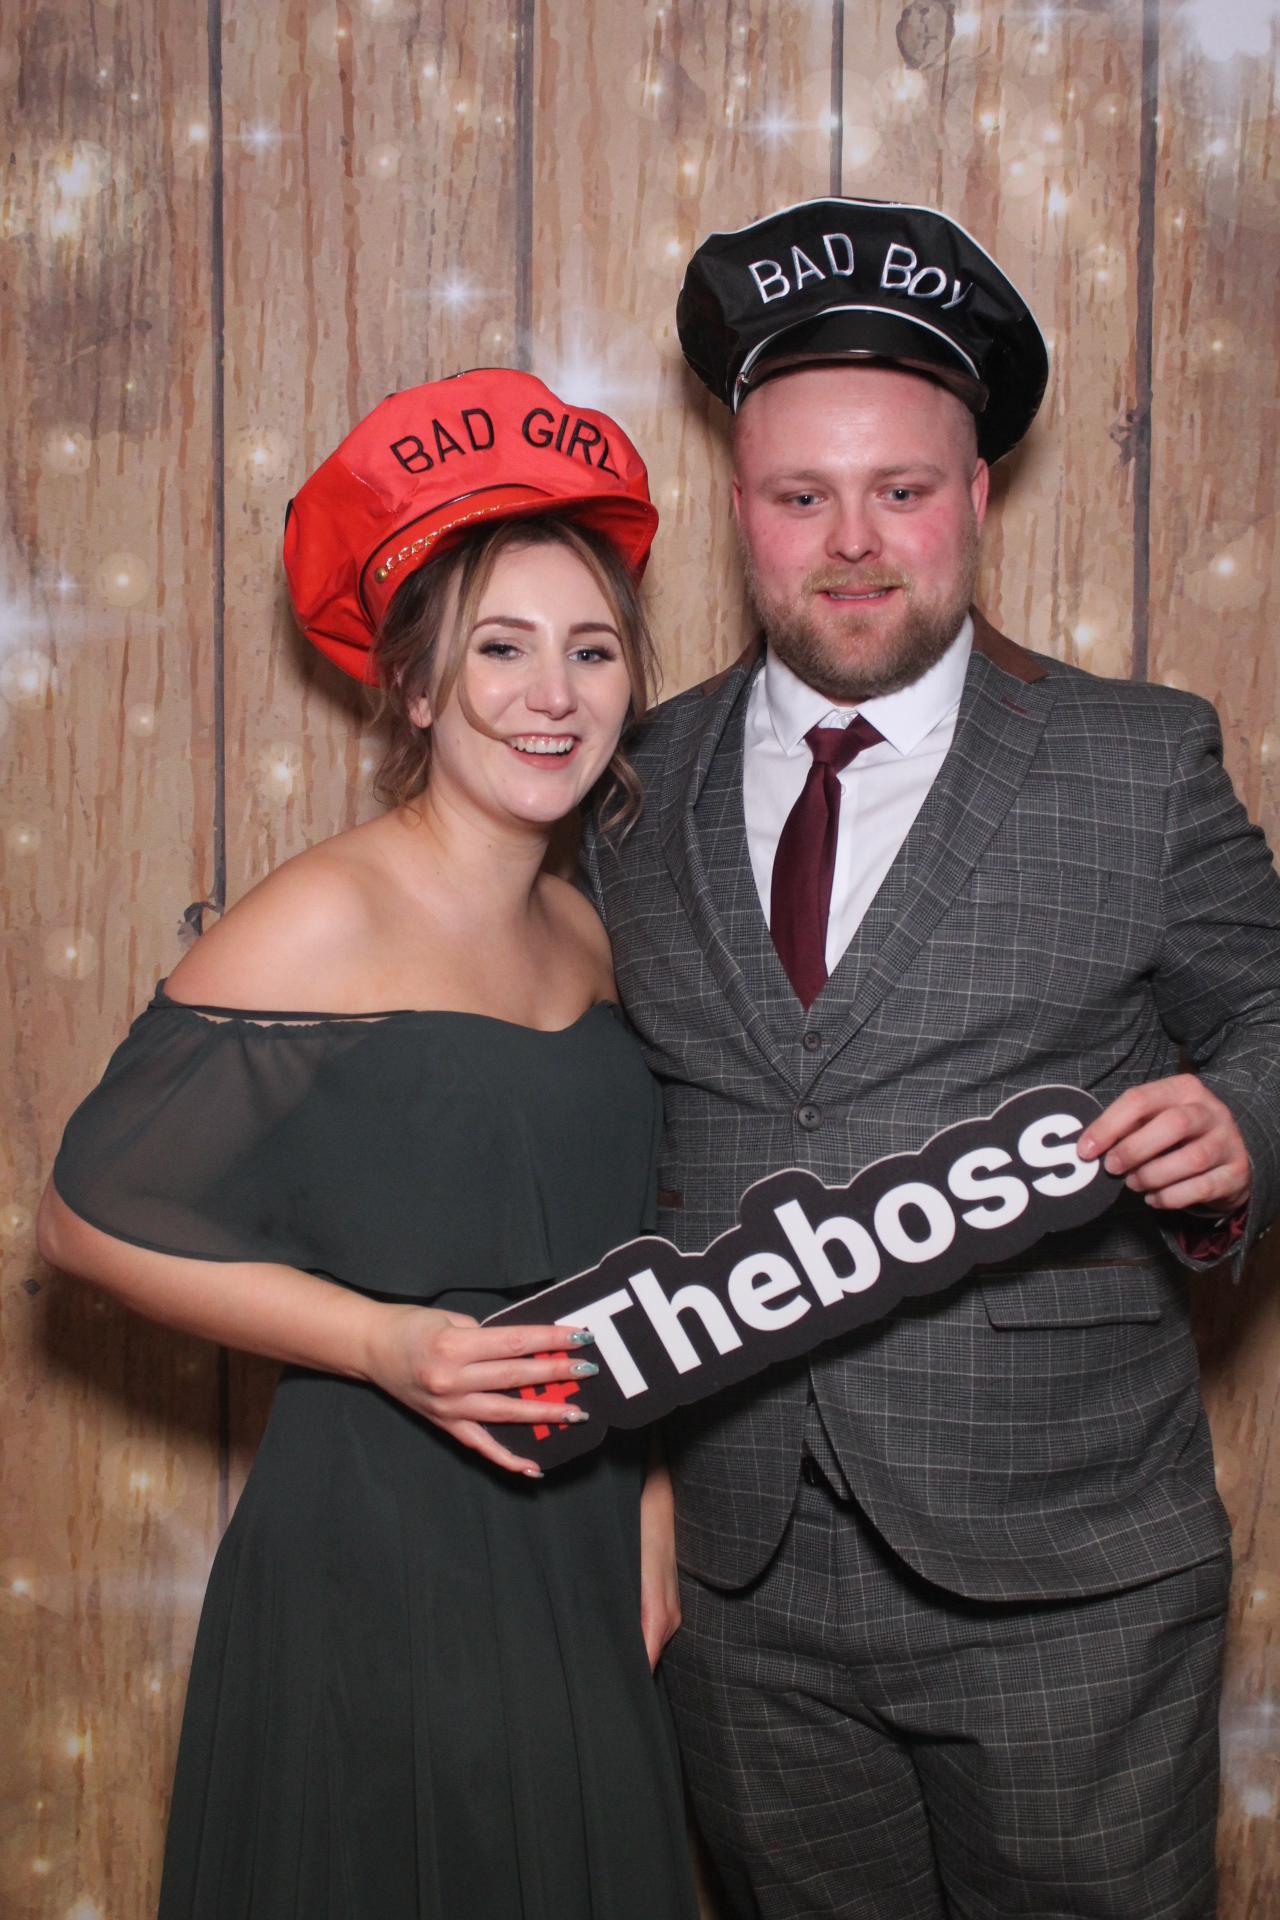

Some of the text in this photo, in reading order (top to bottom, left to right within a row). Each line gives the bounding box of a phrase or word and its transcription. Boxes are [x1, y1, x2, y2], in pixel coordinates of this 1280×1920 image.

[748, 233, 854, 304] BAD
[389, 408, 620, 480] BAD GIRL
